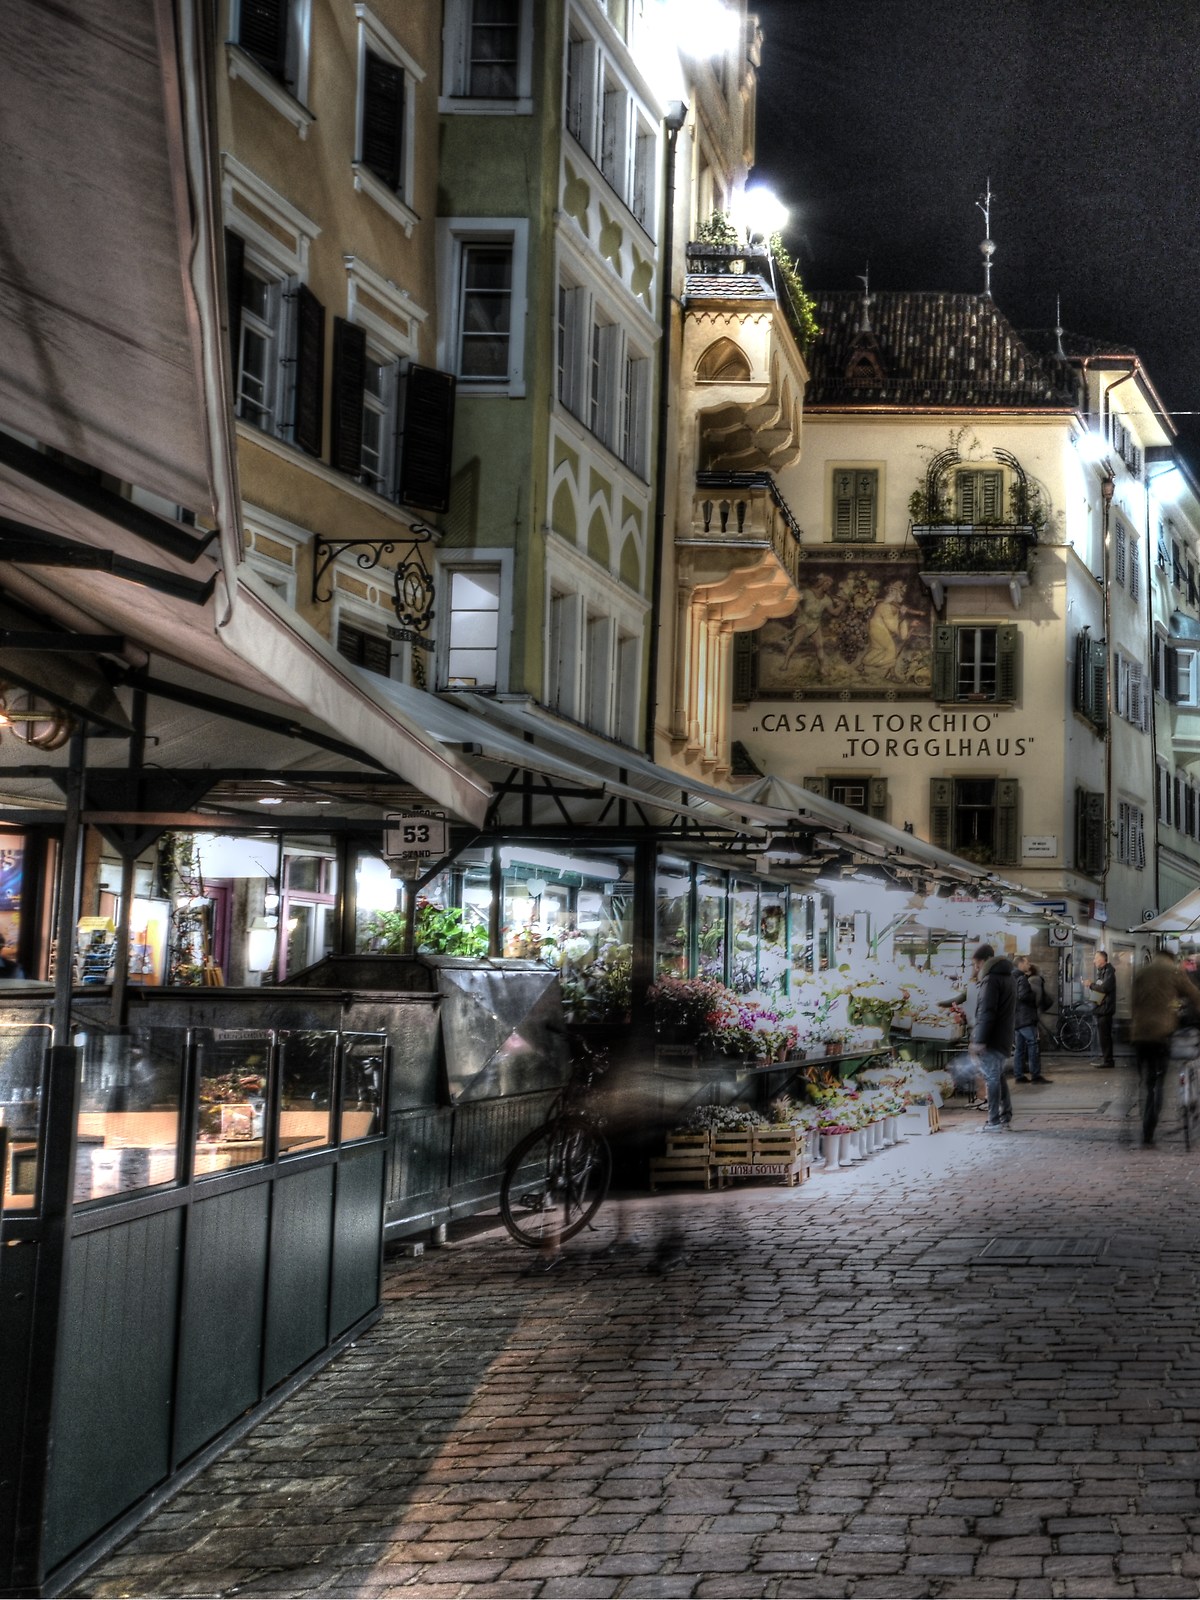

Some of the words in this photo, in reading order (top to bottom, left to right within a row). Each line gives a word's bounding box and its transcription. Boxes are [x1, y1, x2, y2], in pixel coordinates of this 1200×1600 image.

[834, 714, 865, 732] AL
[403, 824, 430, 843] 53
[402, 850, 431, 859] STAND
[730, 1165, 753, 1175] FRUIT
[755, 1164, 781, 1175] TALOS
